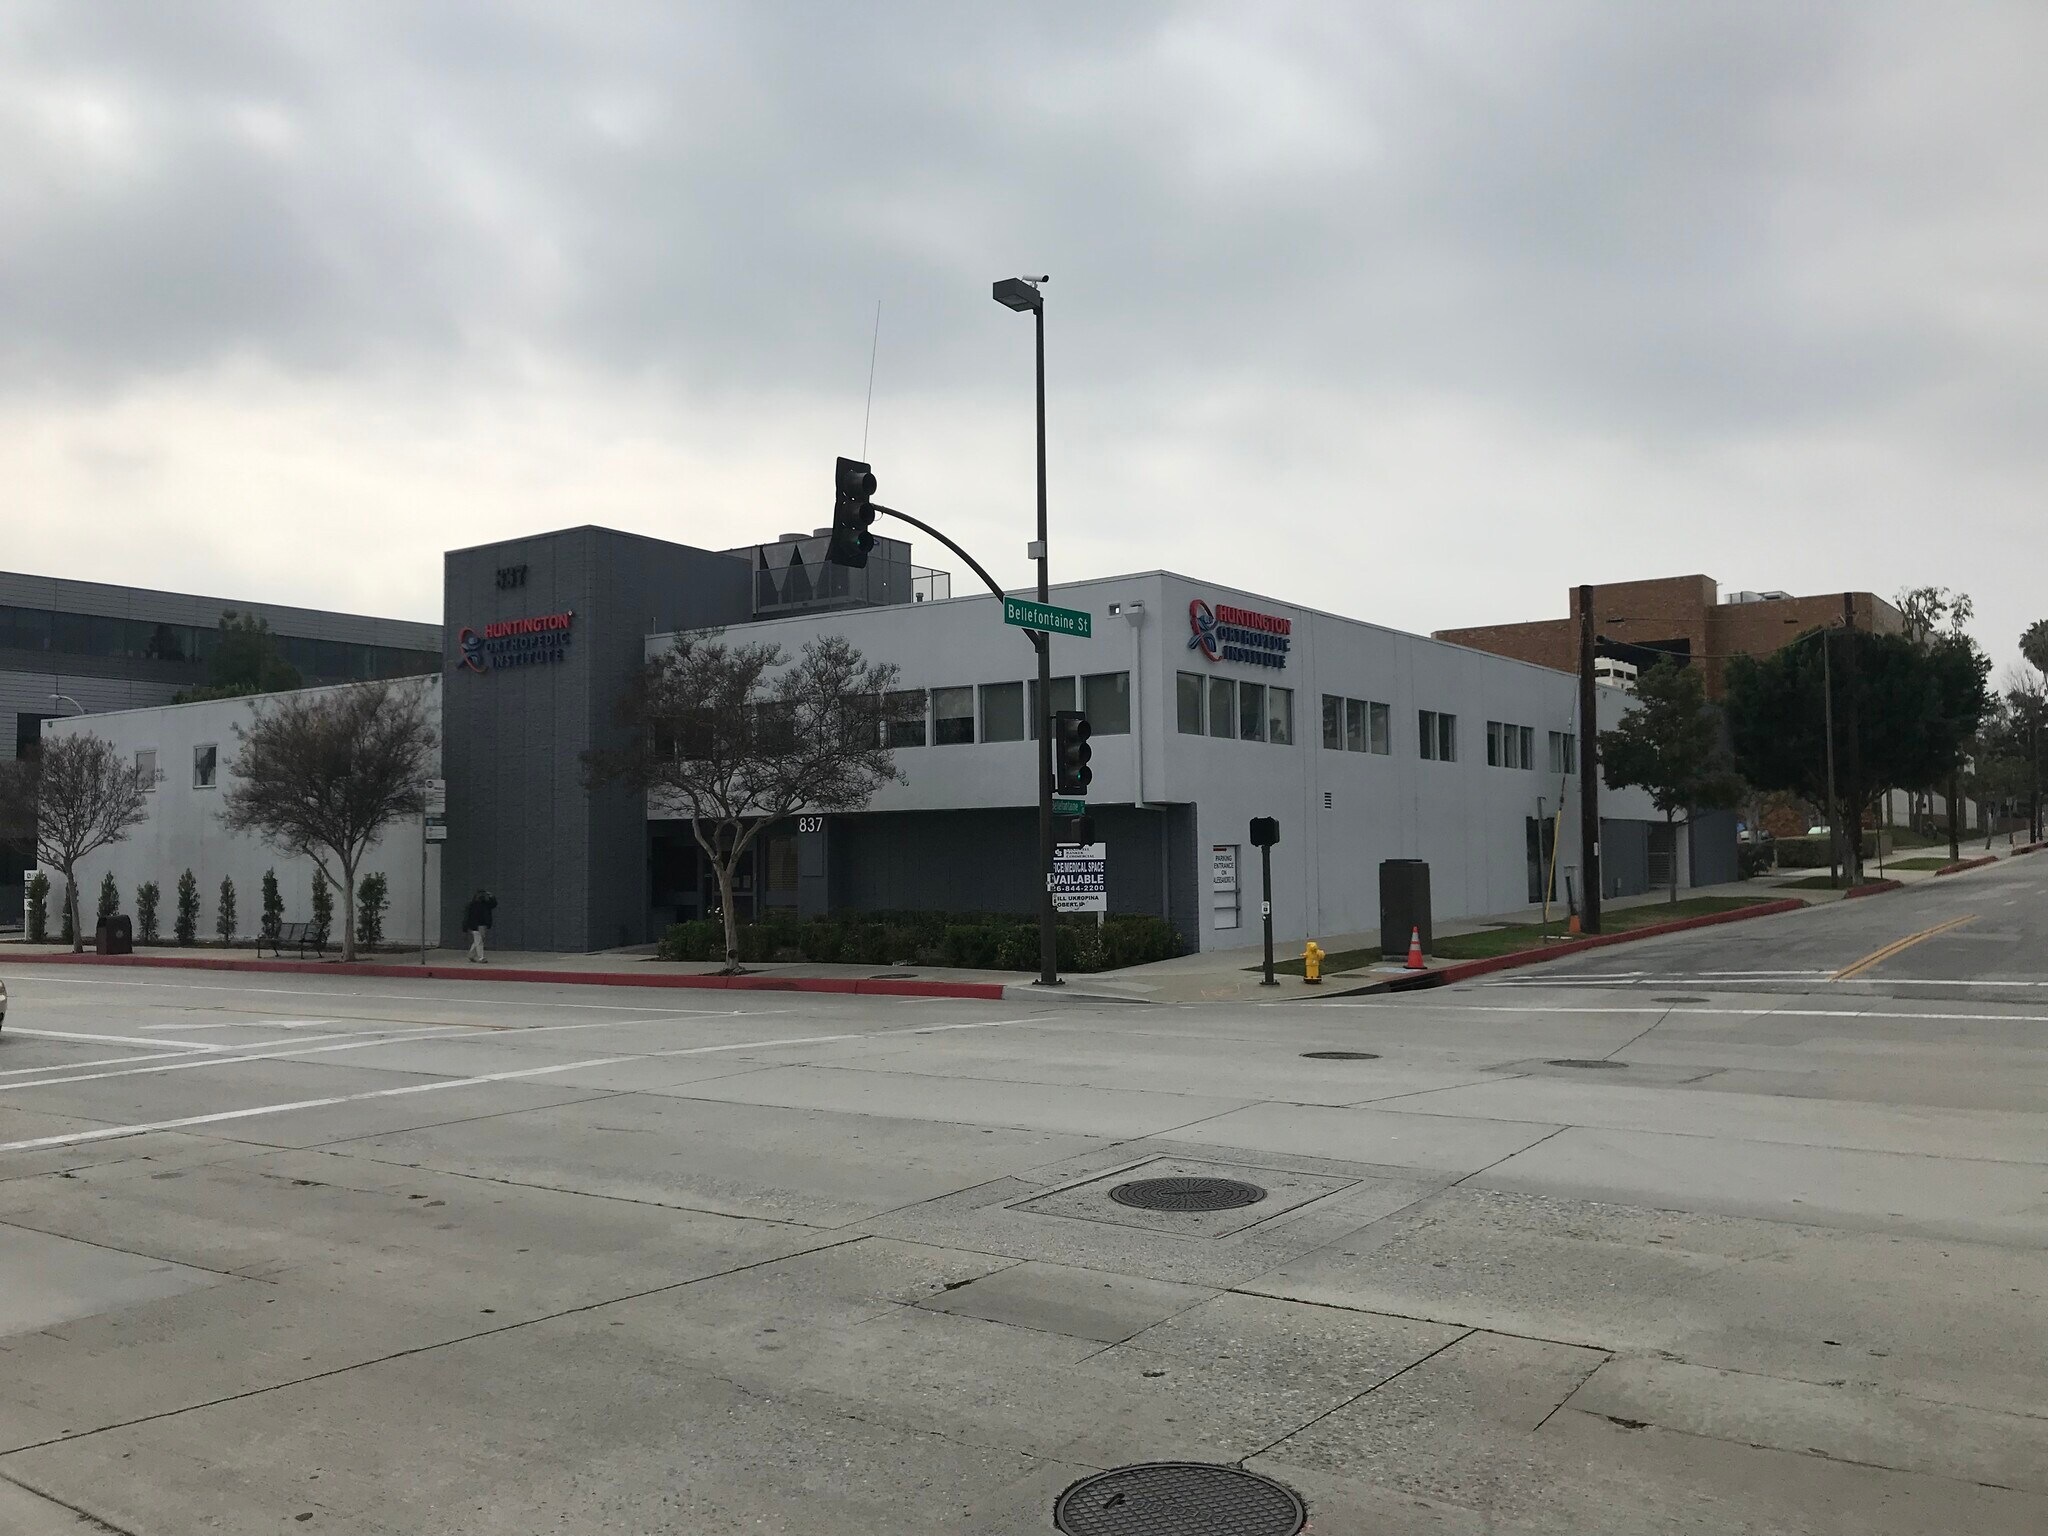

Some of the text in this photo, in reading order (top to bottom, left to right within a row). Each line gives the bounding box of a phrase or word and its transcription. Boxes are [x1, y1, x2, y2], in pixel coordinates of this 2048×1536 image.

[484, 614, 568, 638] HUNTINGTON
[1008, 604, 1088, 632] Bellefontaine St
[1216, 604, 1292, 635] HUNTINGTON
[483, 632, 571, 655] ORTHOPEDIC
[1216, 626, 1291, 652] ORTHOPEDIC
[1223, 645, 1286, 669] INSTITUTE
[799, 817, 823, 832] 837
[1088, 861, 1104, 873] SPACE
[1053, 874, 1104, 885] VAILABLE
